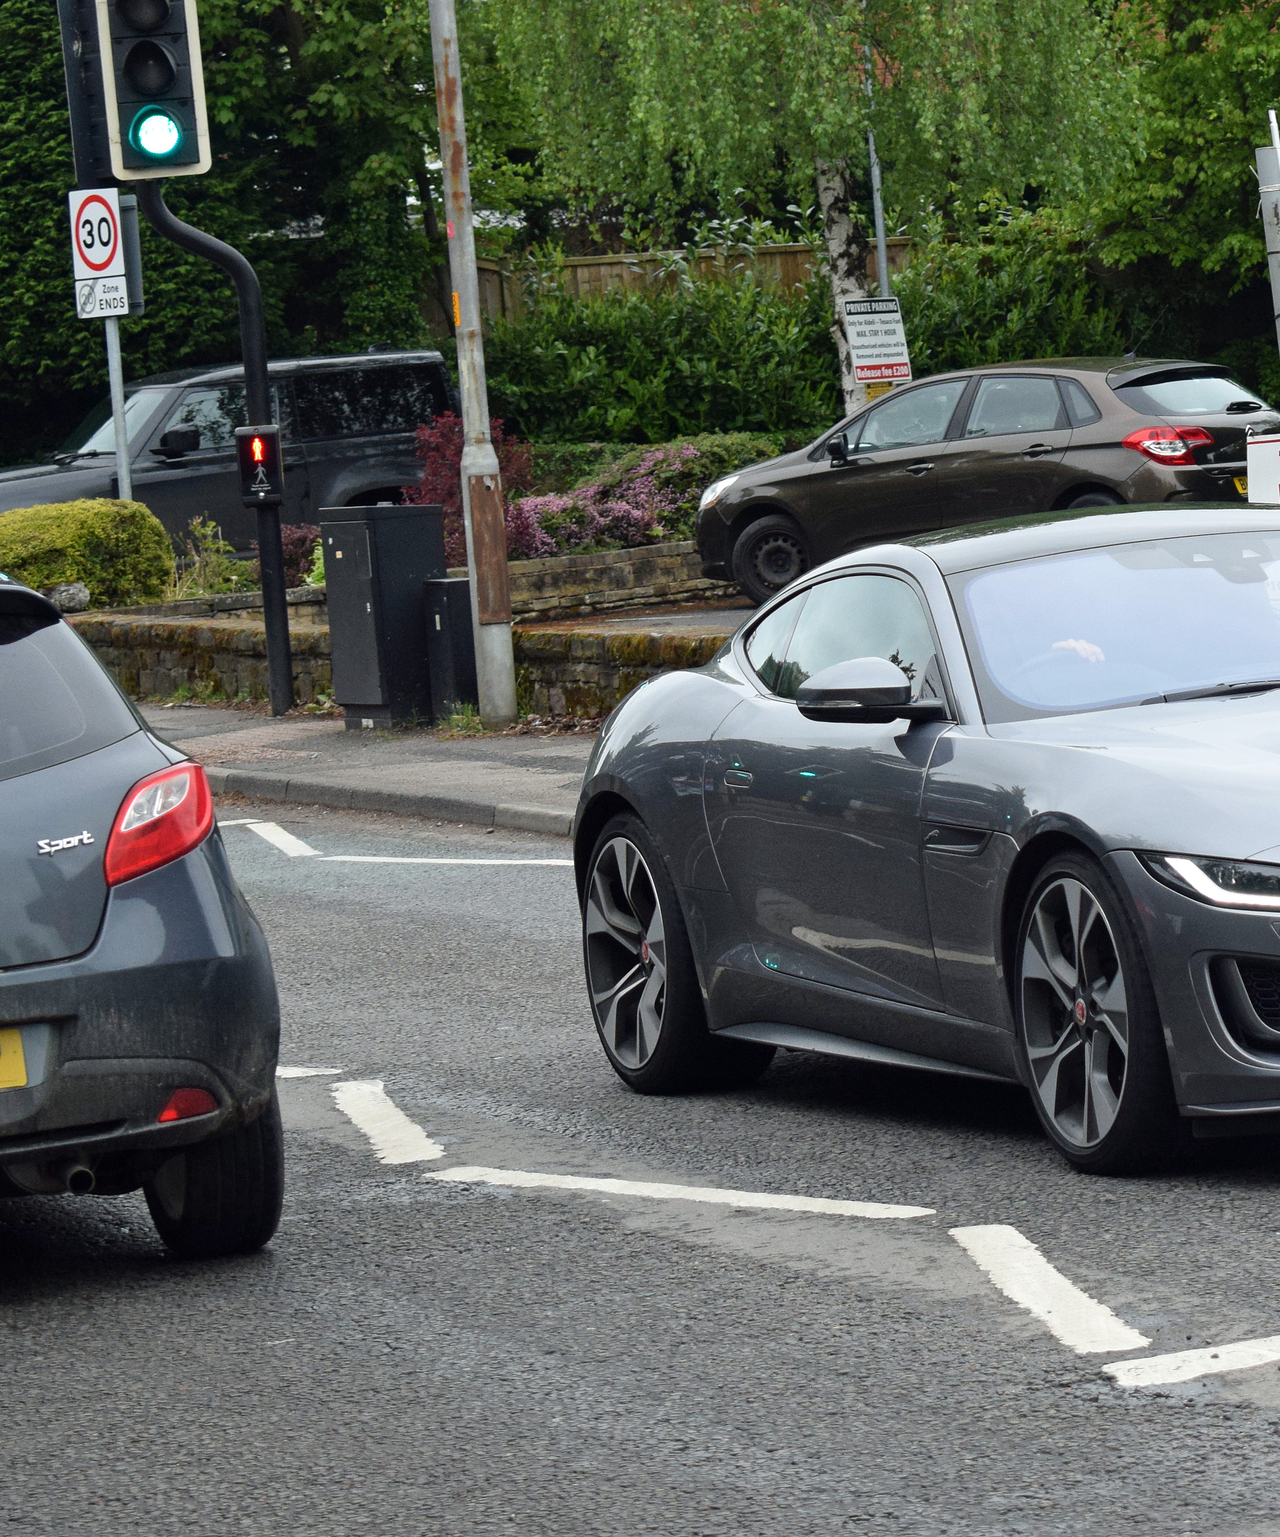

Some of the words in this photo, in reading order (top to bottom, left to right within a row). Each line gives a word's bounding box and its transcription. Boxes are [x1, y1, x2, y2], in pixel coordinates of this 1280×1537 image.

[82, 217, 111, 249] 30
[102, 284, 119, 294] Zone
[81, 293, 94, 306] 20
[99, 297, 125, 310] ENDS
[846, 302, 871, 313] PRIVATE
[871, 301, 897, 312] PARKING
[868, 329, 880, 337] STAY
[883, 328, 898, 336] HOUR
[857, 368, 881, 378] Release
[881, 366, 893, 376] fee
[893, 365, 908, 376] £200
[37, 830, 95, 857] Sport
